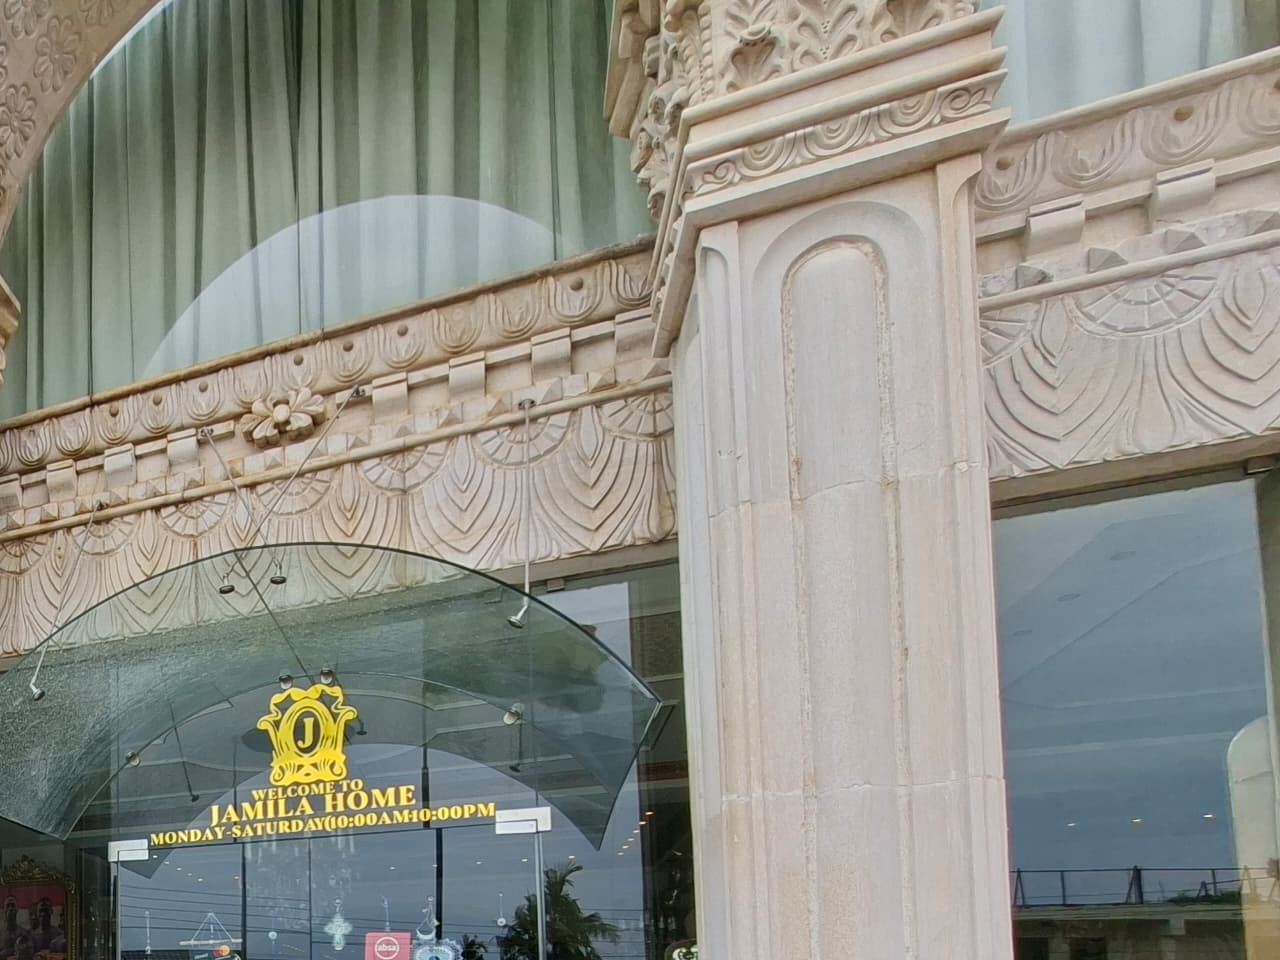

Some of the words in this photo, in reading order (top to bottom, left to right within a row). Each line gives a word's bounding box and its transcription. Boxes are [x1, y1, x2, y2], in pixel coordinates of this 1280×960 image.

[251, 782, 335, 801] WELCOME
[339, 778, 364, 792] TO
[210, 796, 315, 827] JAMILA
[324, 785, 417, 813] HOME
